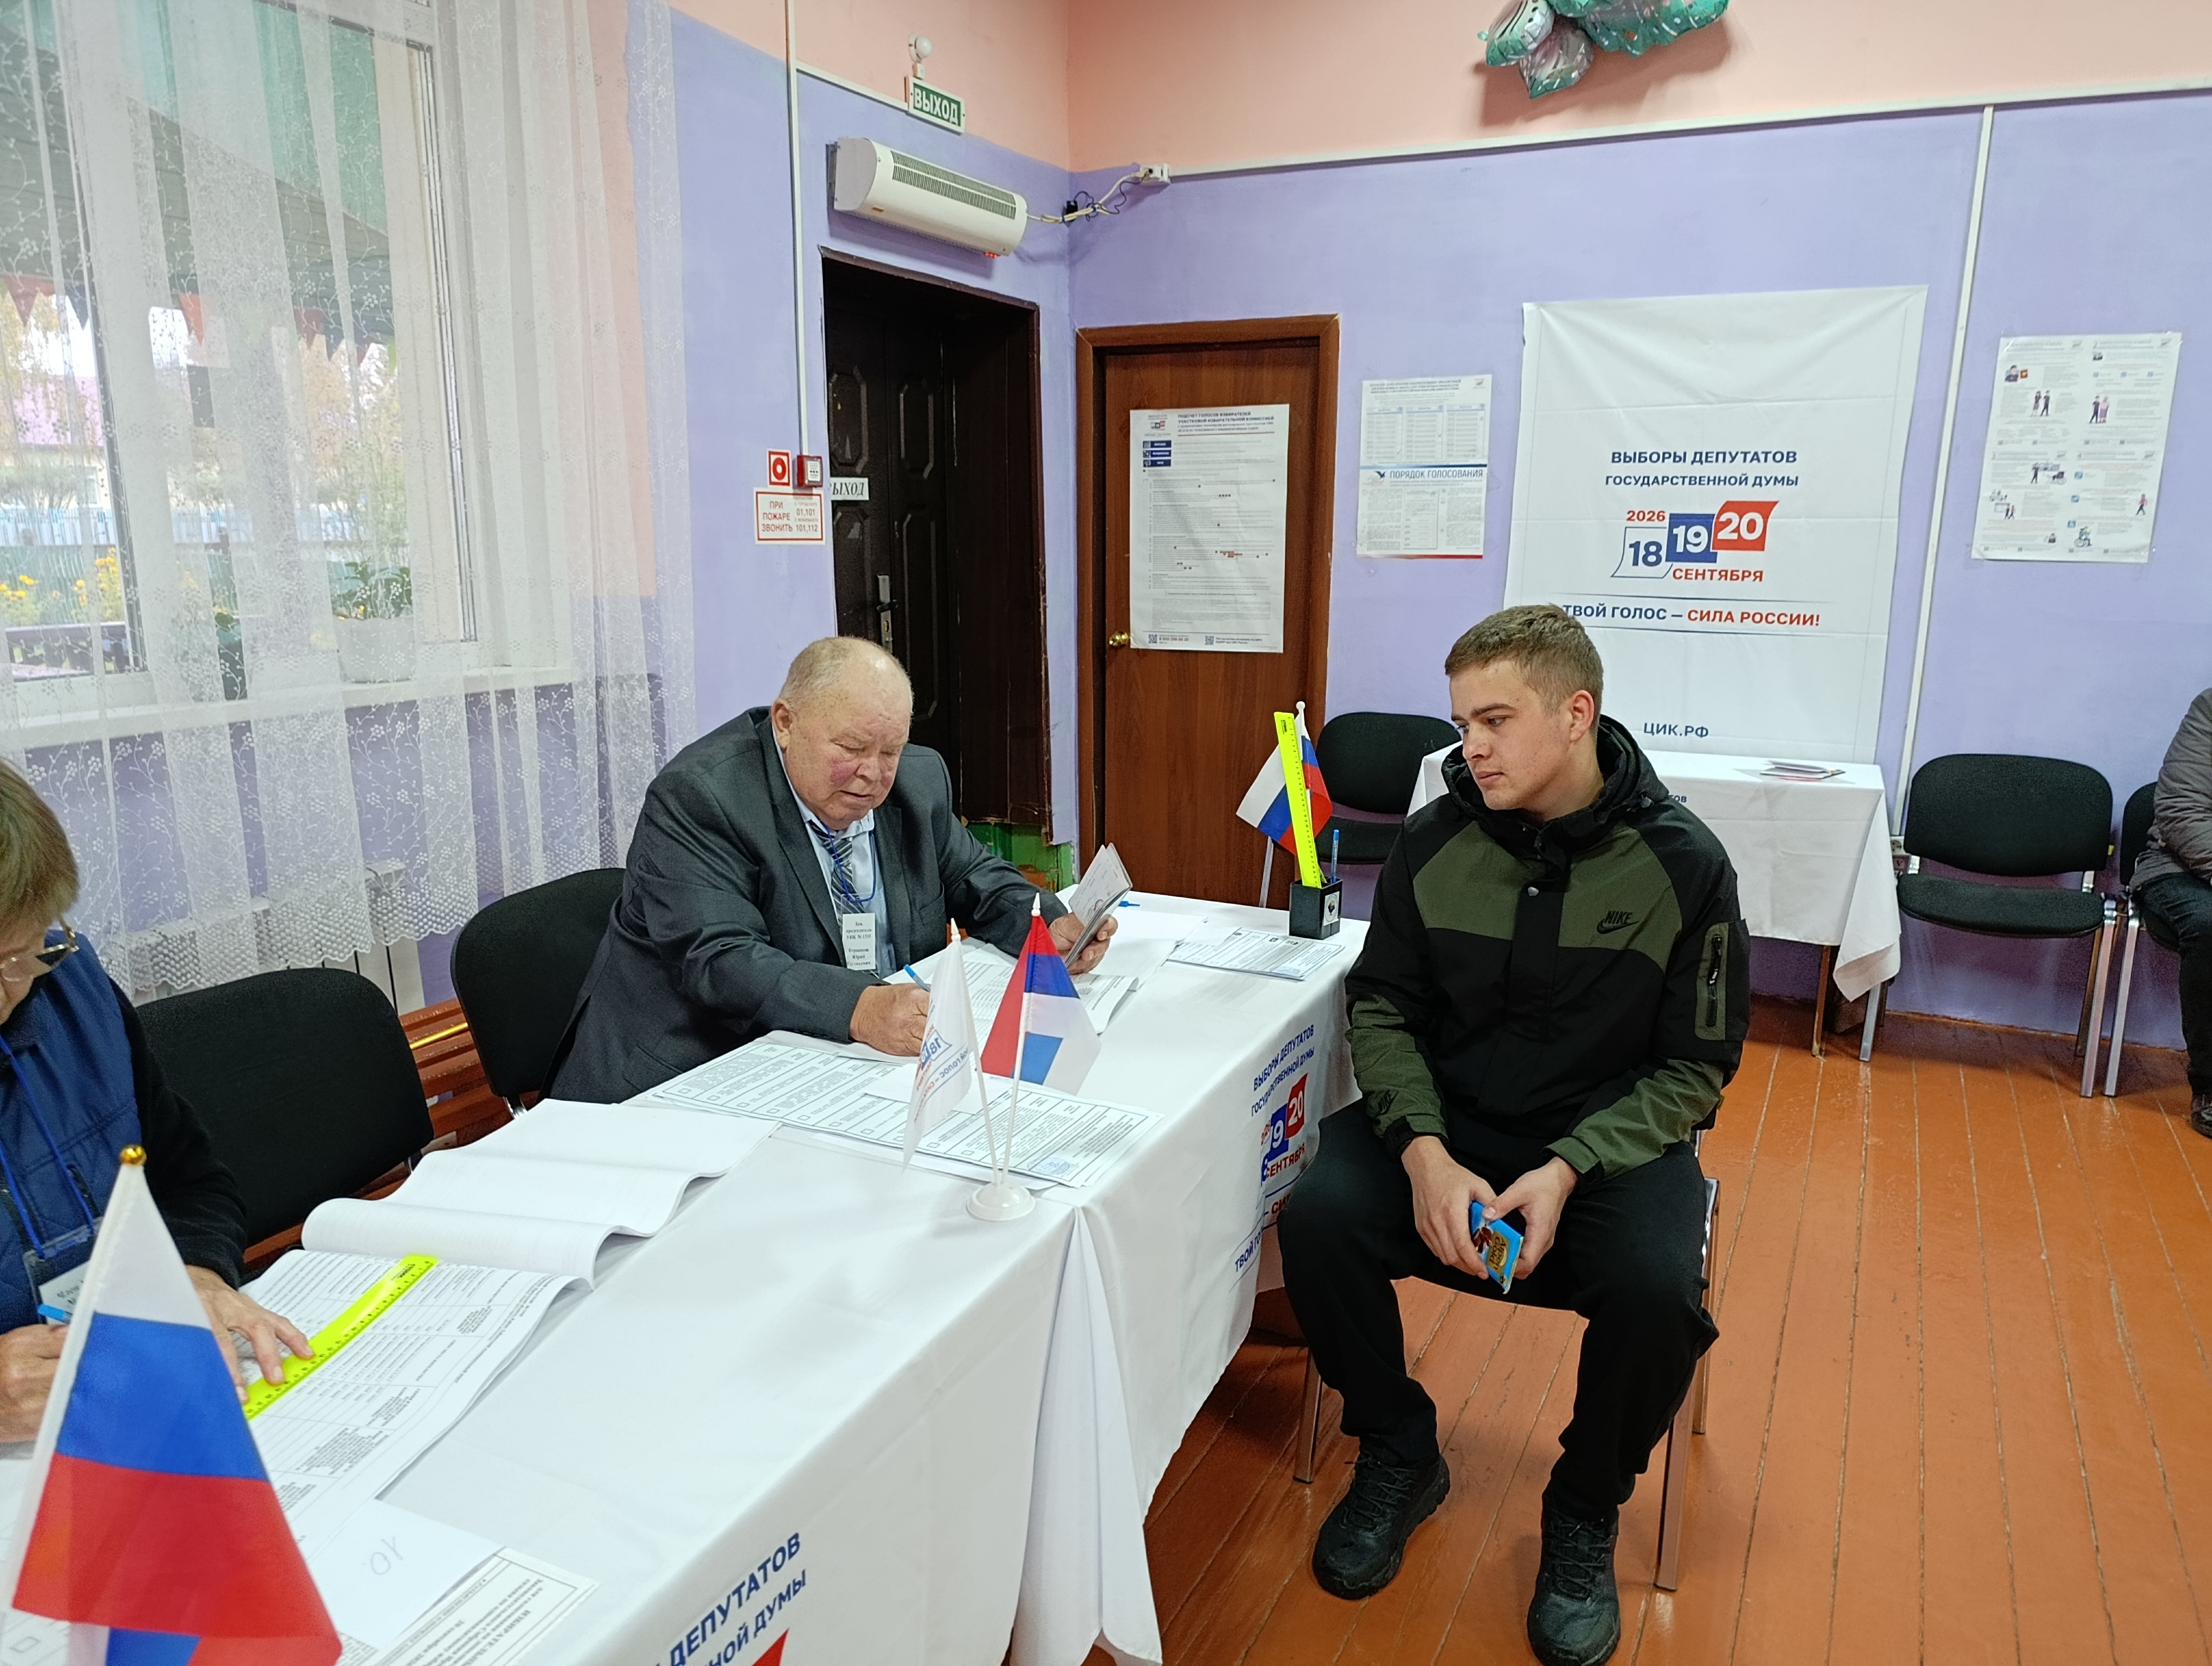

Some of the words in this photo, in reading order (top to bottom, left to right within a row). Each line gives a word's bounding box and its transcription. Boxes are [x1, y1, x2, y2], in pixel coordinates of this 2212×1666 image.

[914, 87, 958, 125] ВЫХОД
[1611, 451, 1687, 464] ВЫБОРЫ
[1690, 451, 1797, 465] ДЕПУТАТОВ
[1390, 471, 1425, 479] ПОРЯДОК
[1427, 470, 1483, 478] ГОЛОСОВАНИЯ
[1605, 473, 1749, 487] ГОСУДАРСТВЕННОЙ
[1752, 475, 1799, 488] ДУМЫ
[831, 482, 864, 496] ЫХОД
[763, 512, 790, 521] ПОЖАРЕ
[797, 508, 815, 517] 01,101
[1626, 510, 1666, 522] 2026
[762, 524, 793, 532] ЗВОНИТЬ
[796, 524, 818, 533] 101,112
[1628, 541, 1663, 567] 18
[1672, 525, 1708, 553] 19
[1716, 512, 1764, 541] 20
[1673, 567, 1764, 582] СЕНТЯБРЯ
[1562, 603, 1606, 618] ТВОЙ
[1611, 606, 1667, 619] ГОЛОС
[1687, 610, 1734, 623] СИЛА
[1740, 612, 1820, 626] РОССИИ!
[1643, 722, 1709, 738] ЦИК.РФ
[1604, 911, 1634, 925] NIKE
[1253, 1053, 1279, 1092] ВЫБОРЫ
[1279, 1024, 1314, 1064] ДЕПУТАТОВ
[1251, 1056, 1300, 1117] ГОСУДАРСТВЕННОЙ
[1300, 1046, 1315, 1068] ДУМЫ
[1288, 1090, 1303, 1126] 20
[1235, 1241, 1253, 1273] ТВОЙ
[1489, 1236, 1500, 1264] Gold
[1493, 1237, 1507, 1271] Alpen
[670, 1533, 801, 1666] ДЕПУТАТОВ
[754, 1569, 807, 1639] ДУМЫ
